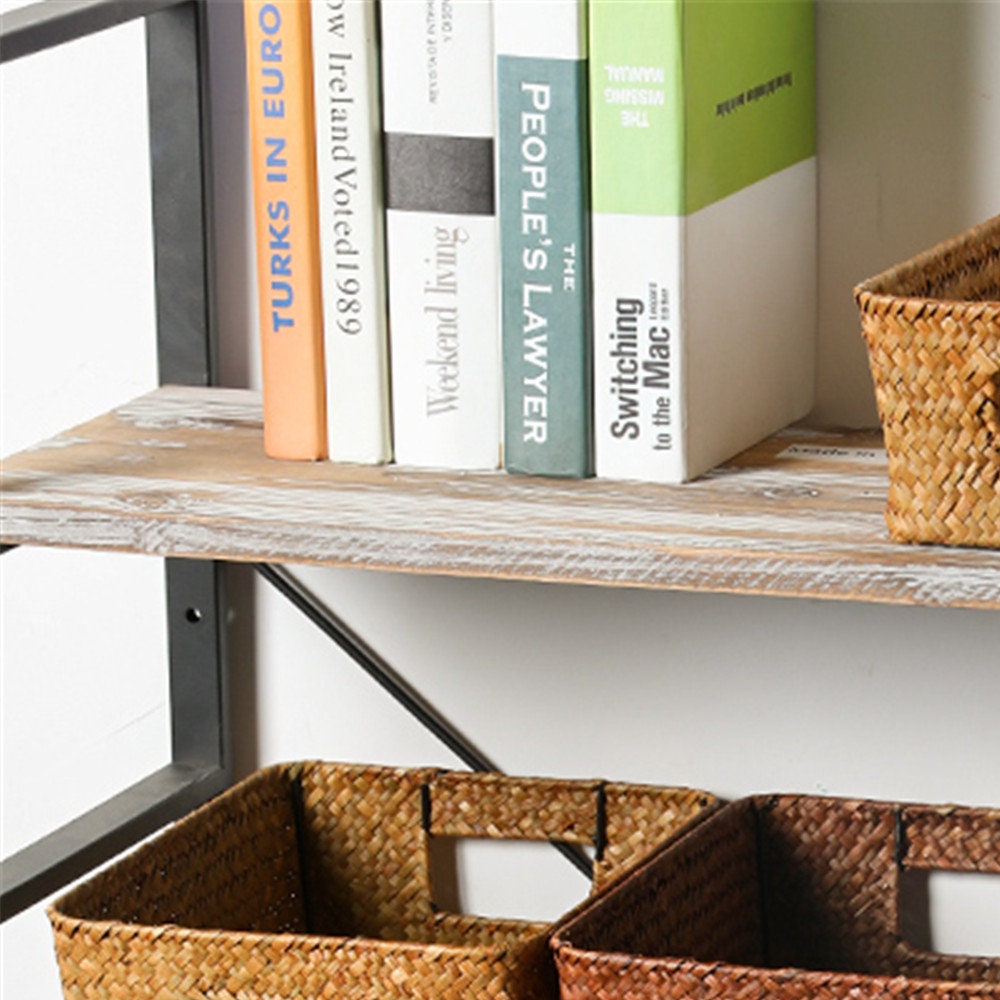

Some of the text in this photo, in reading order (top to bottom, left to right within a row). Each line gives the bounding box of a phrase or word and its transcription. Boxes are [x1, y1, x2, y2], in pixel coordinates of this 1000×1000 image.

[328, 53, 354, 161] Ireland
[620, 109, 649, 128] THE
[258, 3, 294, 332] TURKS IN EURO
[333, 167, 360, 256] Voted
[335, 263, 362, 335] 1989
[521, 82, 553, 444] PEOPLE'S LAWYER
[563, 243, 577, 292] THE
[424, 226, 470, 417] Weekend living
[642, 326, 671, 389] Mac
[609, 298, 645, 440] Switching
[652, 396, 671, 427] the
[653, 433, 672, 451] to
